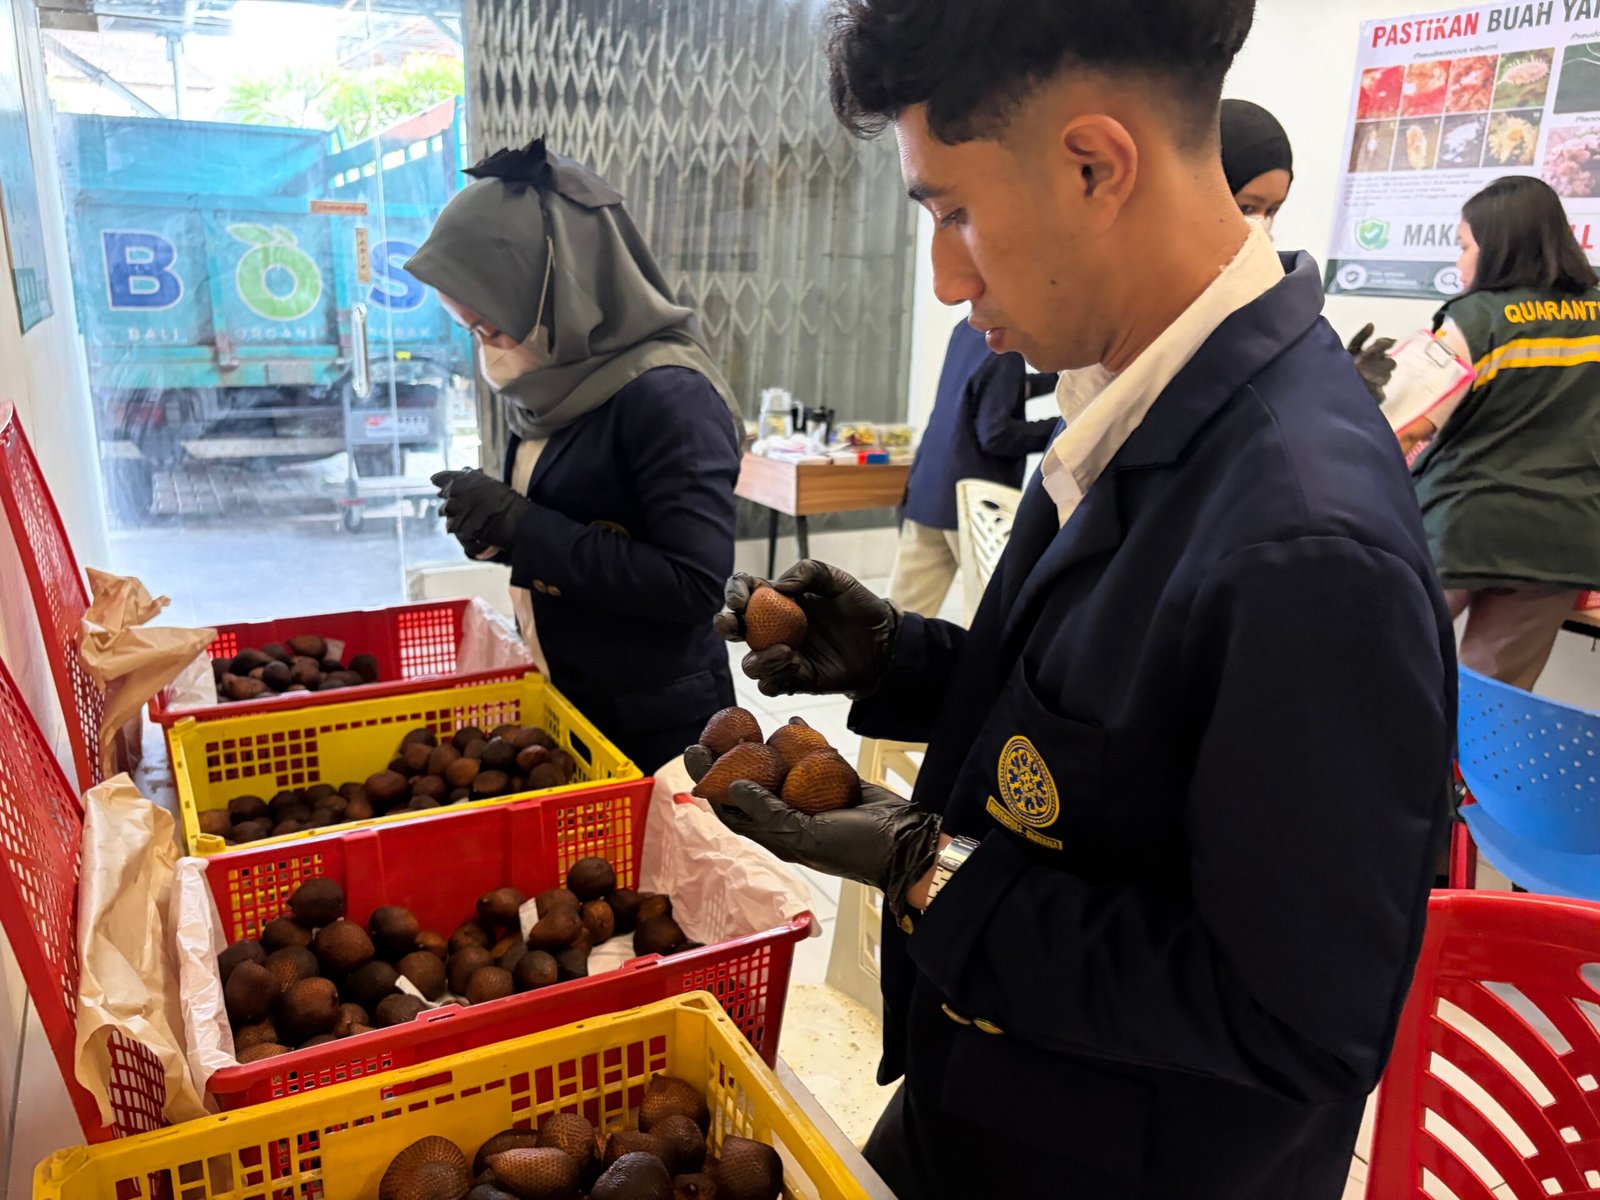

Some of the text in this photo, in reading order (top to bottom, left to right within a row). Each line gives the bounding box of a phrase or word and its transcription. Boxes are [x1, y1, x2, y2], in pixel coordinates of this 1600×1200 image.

[1371, 12, 1480, 48] PASTIKAN
[1487, 1, 1554, 33] BUAH
[1503, 299, 1600, 324] QUARANT
